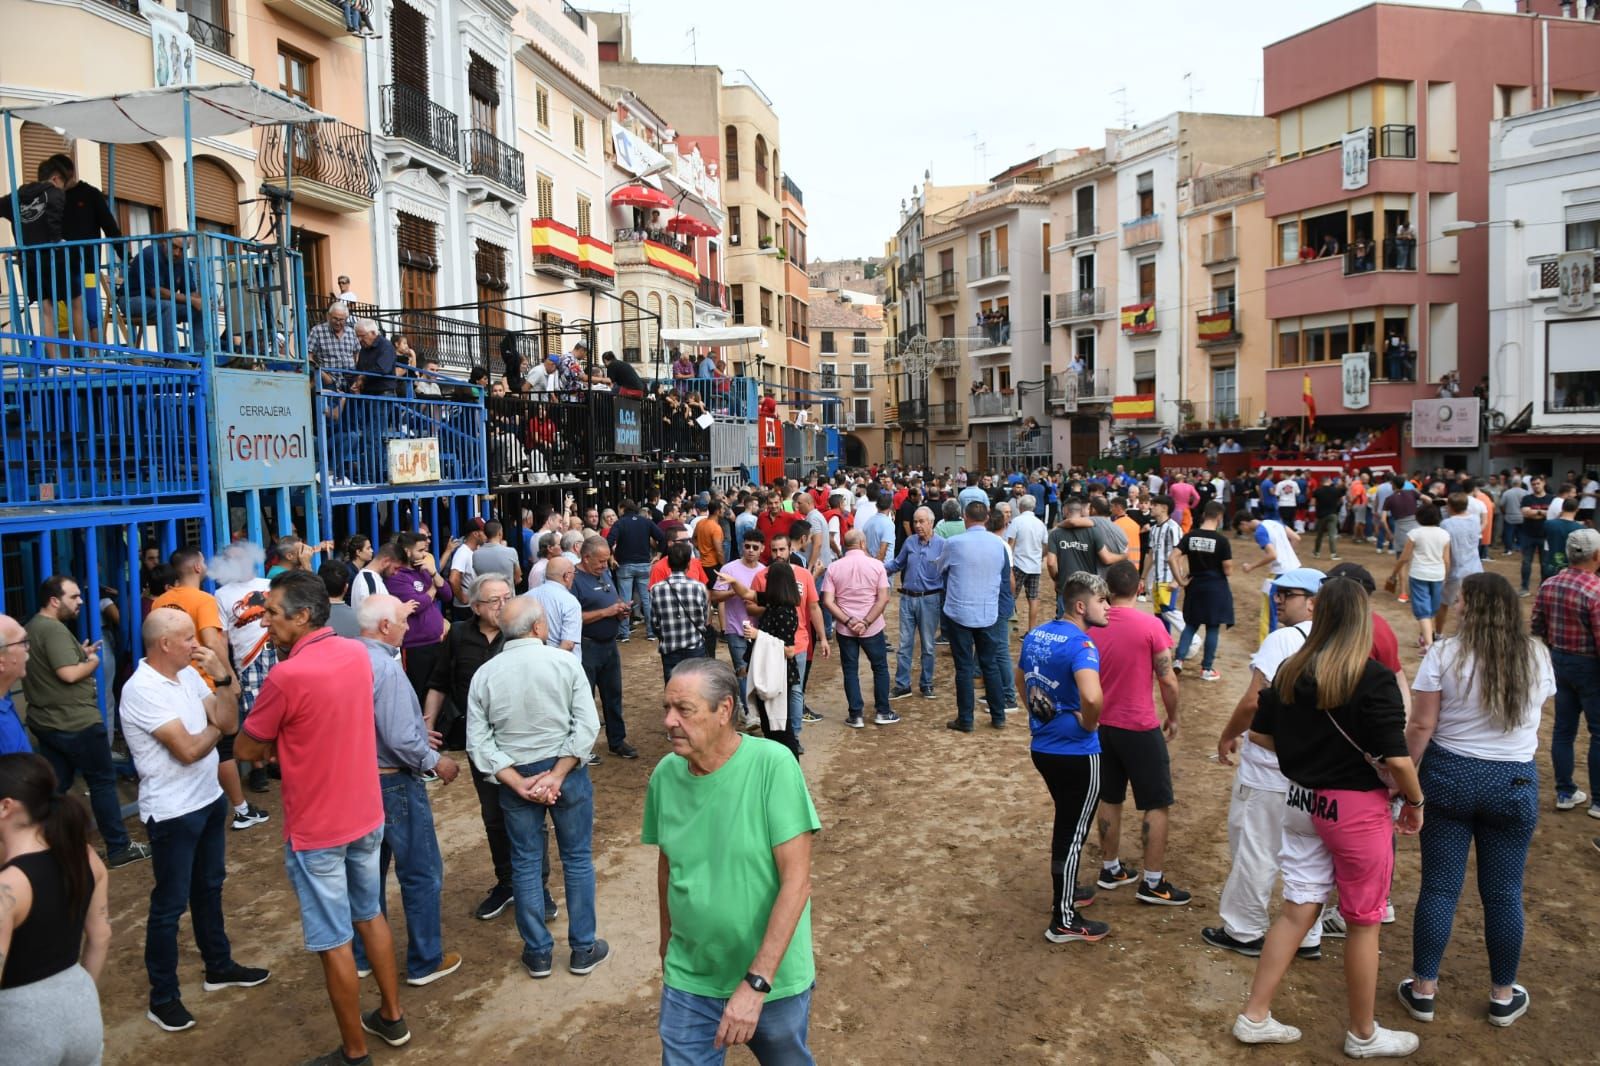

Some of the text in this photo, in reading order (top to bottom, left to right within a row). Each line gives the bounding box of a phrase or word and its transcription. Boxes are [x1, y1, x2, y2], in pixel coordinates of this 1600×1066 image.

[239, 405, 292, 417] CERRAJERIA
[227, 424, 308, 462] ferroal
[1286, 784, 1338, 823] SANDRA
